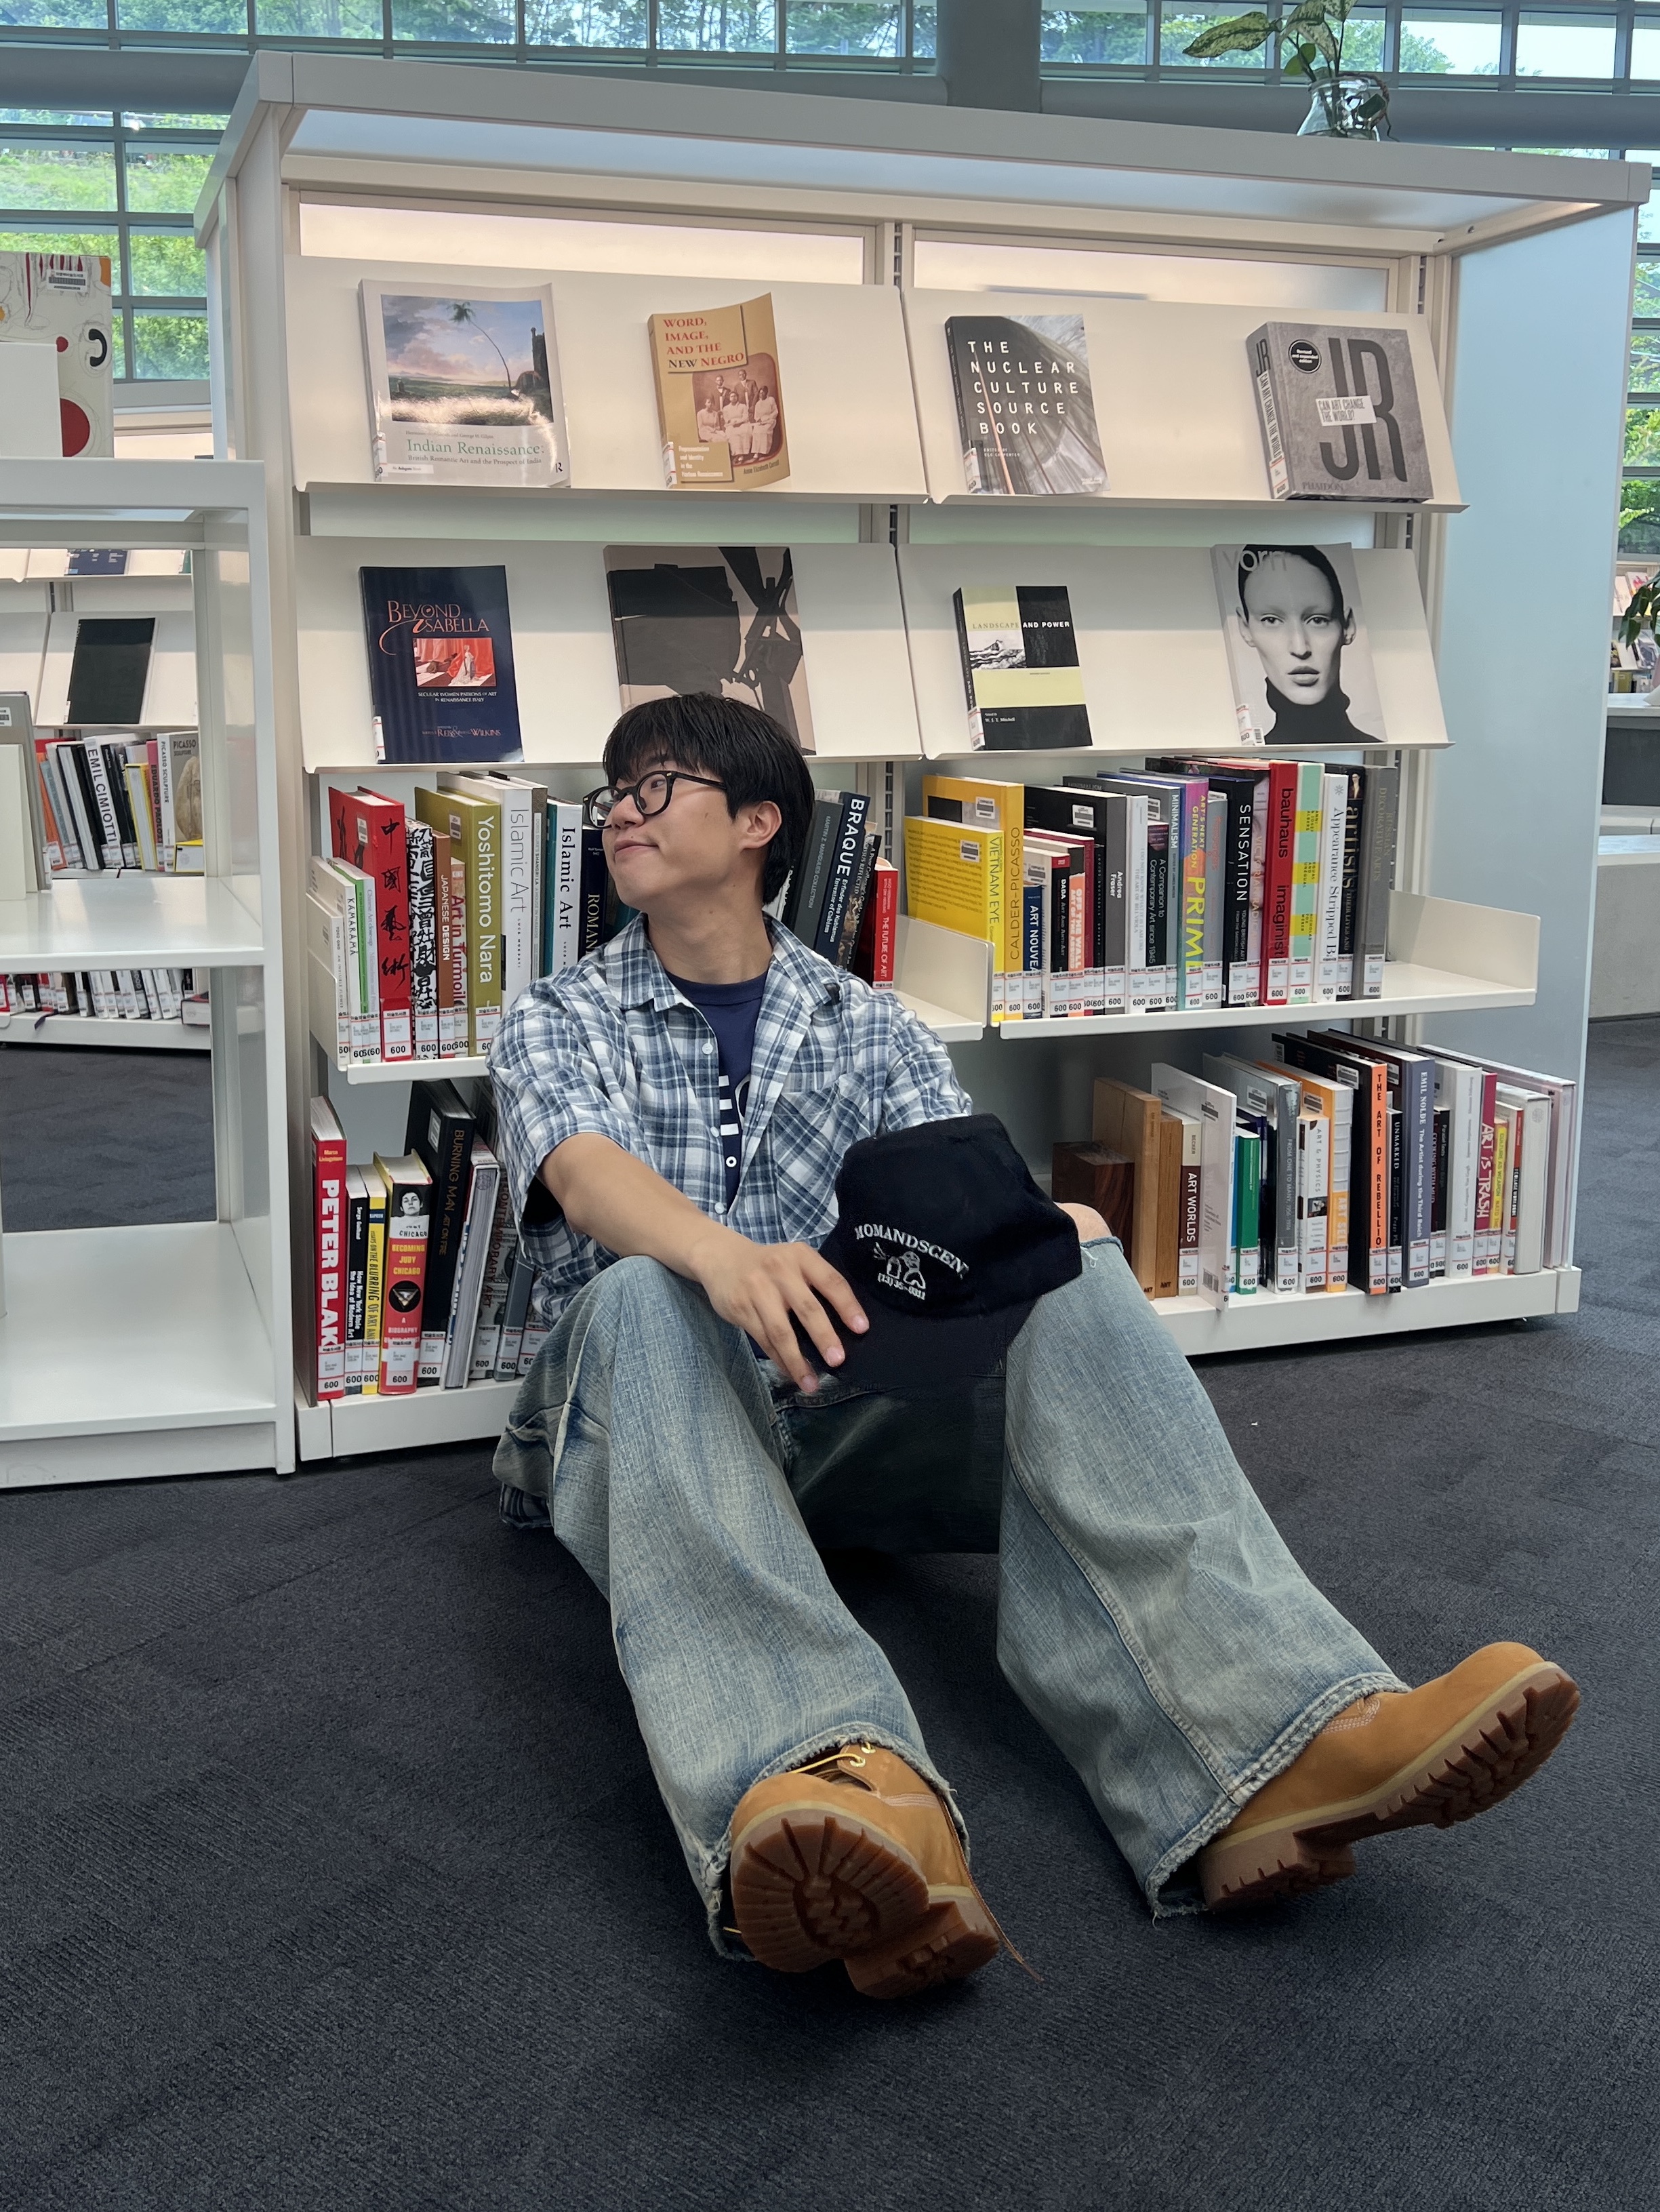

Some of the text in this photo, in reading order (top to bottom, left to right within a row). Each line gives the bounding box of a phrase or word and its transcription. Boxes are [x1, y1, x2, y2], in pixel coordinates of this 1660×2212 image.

[663, 317, 707, 327] WORD,
[665, 331, 708, 341] IMAGE,
[667, 342, 721, 355] AND THE
[968, 341, 1009, 353] THE
[668, 353, 744, 368] NEW NEGRO
[1256, 339, 1270, 376] JR
[971, 361, 1075, 374] NUCLEAR
[974, 382, 1078, 394] CULTURE
[977, 402, 1065, 414] SOURCE
[1320, 338, 1408, 482] JR
[979, 422, 1037, 434] BOOK
[407, 439, 544, 456] Indian Renaissance:
[1302, 481, 1343, 491] PHAIDON
[173, 739, 197, 749] PICASSO
[87, 749, 117, 842] EMIL CIMIOTTI
[837, 799, 865, 876] BRAQUE
[1190, 806, 1199, 868] GENERATION
[1373, 787, 1387, 881] DECORATIVE ARTS
[1383, 812, 1394, 856] RUSSIAN
[1236, 804, 1251, 901] SENSATION
[1342, 806, 1360, 889] artists
[510, 809, 529, 913] Islamic Art
[559, 827, 575, 929] Islamic Art
[989, 837, 1000, 924] VIETNAM EYE
[1273, 788, 1294, 958] bauhaus imaginist
[1326, 807, 1344, 939] Appearance Stripped
[830, 877, 841, 903] Inventor
[838, 879, 848, 903] Erfinder
[1010, 827, 1020, 960] CALDER-PICASSO
[1148, 860, 1157, 911] Contemporary
[1157, 866, 1166, 908] Companion
[478, 816, 495, 984] Yoshitomo Nara
[441, 875, 450, 961] JAPANESE DESIGN
[824, 911, 834, 933] Cubism
[830, 914, 841, 943] Kubismus
[451, 896, 467, 1003] Art in Turmoil
[881, 954, 887, 963] OF
[1108, 997, 1121, 1005] 600
[1133, 999, 1146, 1007] 600
[1149, 997, 1162, 1005] 600
[1205, 992, 1219, 1001] 600
[1272, 990, 1284, 998] 600
[1028, 1002, 1040, 1010] 600
[390, 1045, 406, 1054] 600
[1481, 1123, 1494, 1150] ART
[1377, 1147, 1381, 1164] OF
[445, 1129, 465, 1211] BURNING MAN
[1477, 1171, 1491, 1218] TRASH
[1186, 1172, 1197, 1243] ART WORLDS
[321, 1180, 340, 1269] PETER
[369, 1252, 378, 1262] THE
[399, 1255, 416, 1264] JUDY
[393, 1267, 421, 1275] CHICAGO
[367, 1264, 380, 1301] BLURRING
[1182, 1278, 1195, 1286] 600
[369, 1304, 380, 1313] OF
[367, 1314, 376, 1327] ART
[392, 1375, 407, 1383] 600
[422, 1367, 437, 1375] 600
[324, 1380, 339, 1388] 600
